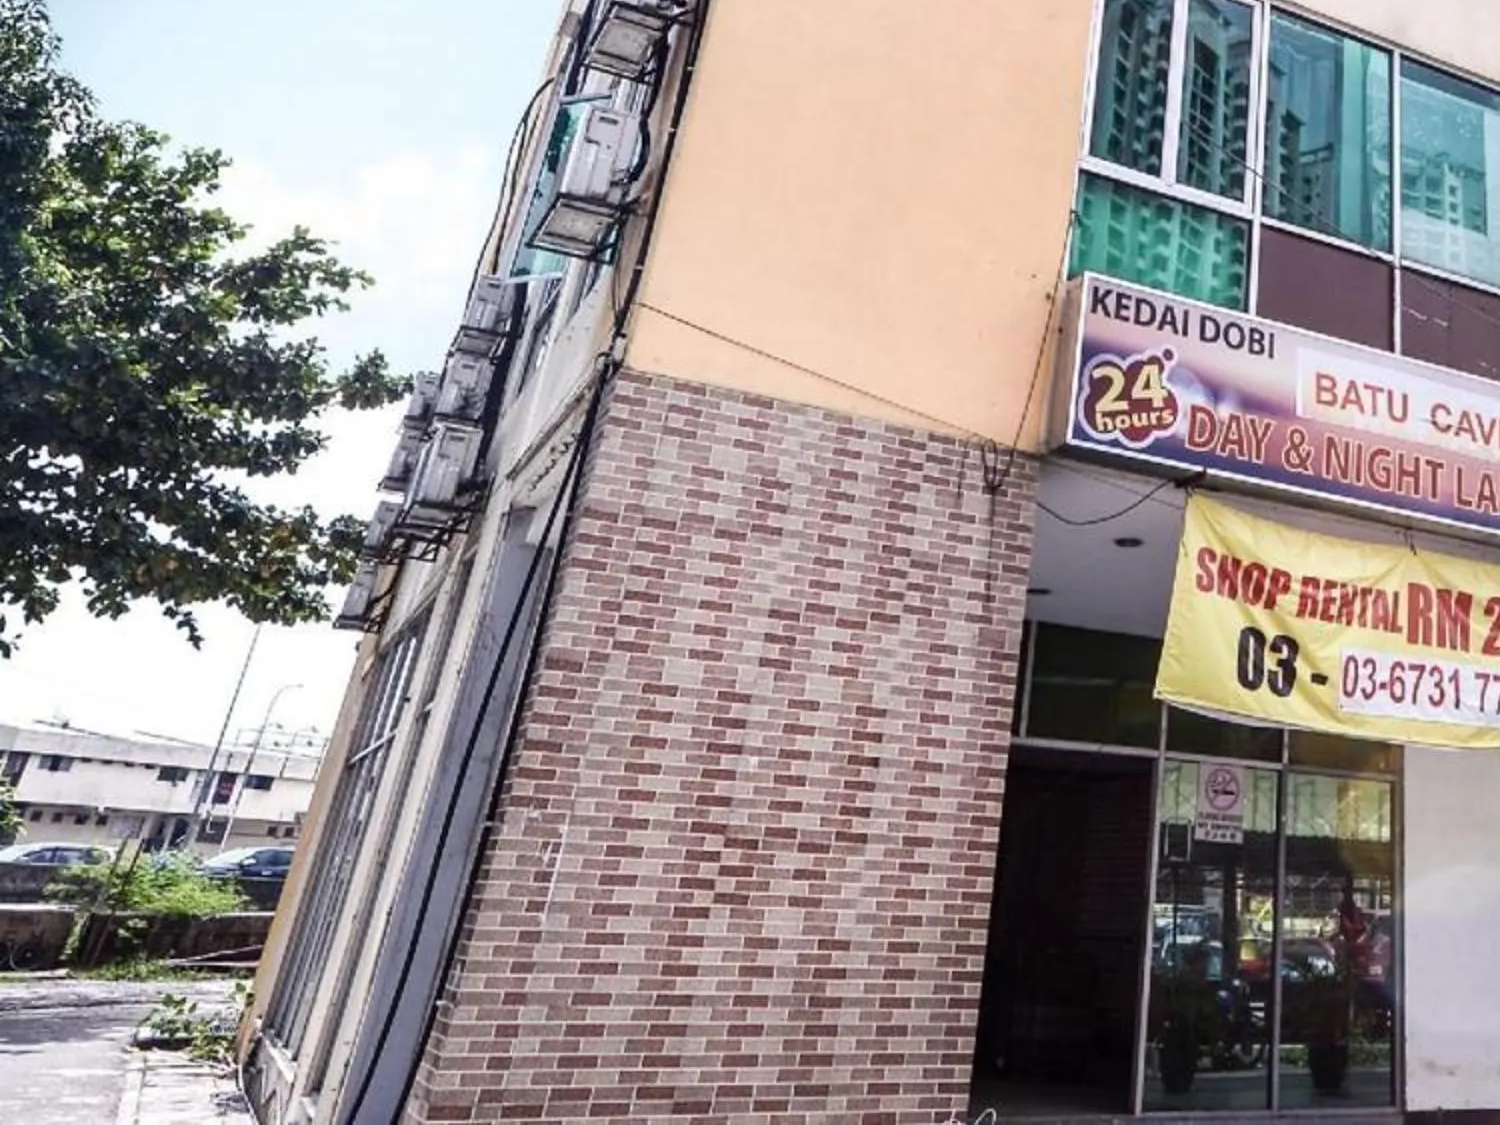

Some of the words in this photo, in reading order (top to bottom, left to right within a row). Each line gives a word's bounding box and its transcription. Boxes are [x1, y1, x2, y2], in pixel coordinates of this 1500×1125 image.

[1090, 286, 1189, 337] KEDAI
[1199, 315, 1275, 359] DOBI
[1092, 364, 1168, 412] 24
[1096, 407, 1175, 432] hours
[1313, 371, 1409, 424] BATU
[1185, 405, 1272, 467] DAY
[1281, 430, 1313, 471] &
[1324, 437, 1445, 502] NIGHT
[1195, 546, 1293, 610] SHOP
[1296, 576, 1403, 634] RENTAL
[1405, 581, 1472, 652] RM
[1237, 627, 1299, 697] 03
[1342, 654, 1462, 713] 03-6731
